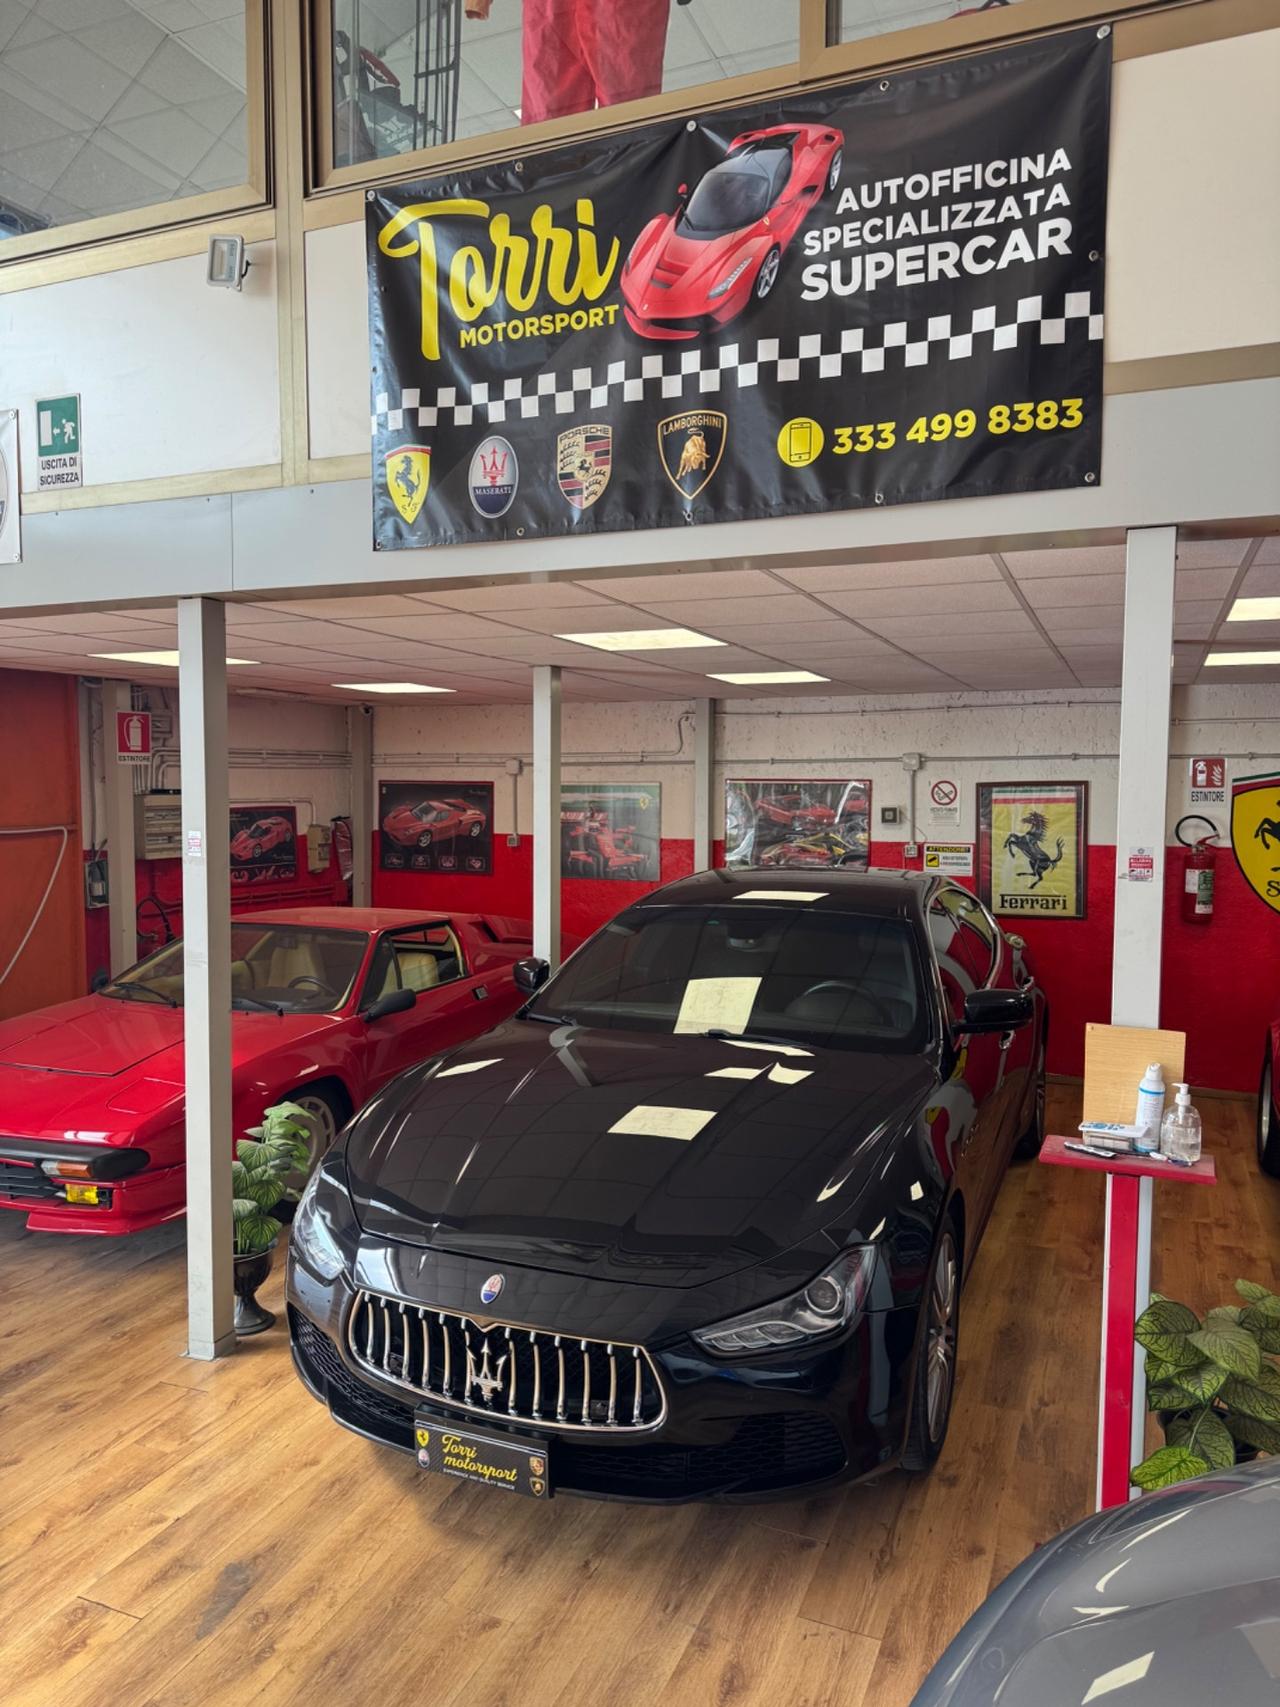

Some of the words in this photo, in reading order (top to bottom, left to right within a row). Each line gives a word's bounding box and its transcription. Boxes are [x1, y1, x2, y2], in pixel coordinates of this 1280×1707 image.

[835, 148, 1072, 215] AUTOFFICINA
[803, 183, 1071, 256] SPECIALIZZATA
[800, 217, 1073, 301] SUPERCAR
[378, 198, 620, 361] Torri
[460, 304, 619, 348] MOTORSPORT
[559, 426, 610, 443] PORSCHE
[663, 414, 722, 435] LAMBORGHINI
[832, 422, 896, 455] 333
[906, 409, 976, 443] 499
[988, 398, 1084, 434] 8383
[41, 458, 67, 470] USCITA
[69, 456, 77, 467] DI
[40, 472, 79, 485] SICUREZZA
[475, 486, 512, 495] MASERATI
[1191, 790, 1225, 802] ESTINTORE
[999, 894, 1067, 910] Ferrari
[442, 1434, 477, 1458] Torri
[444, 1456, 518, 1482] motorsport
